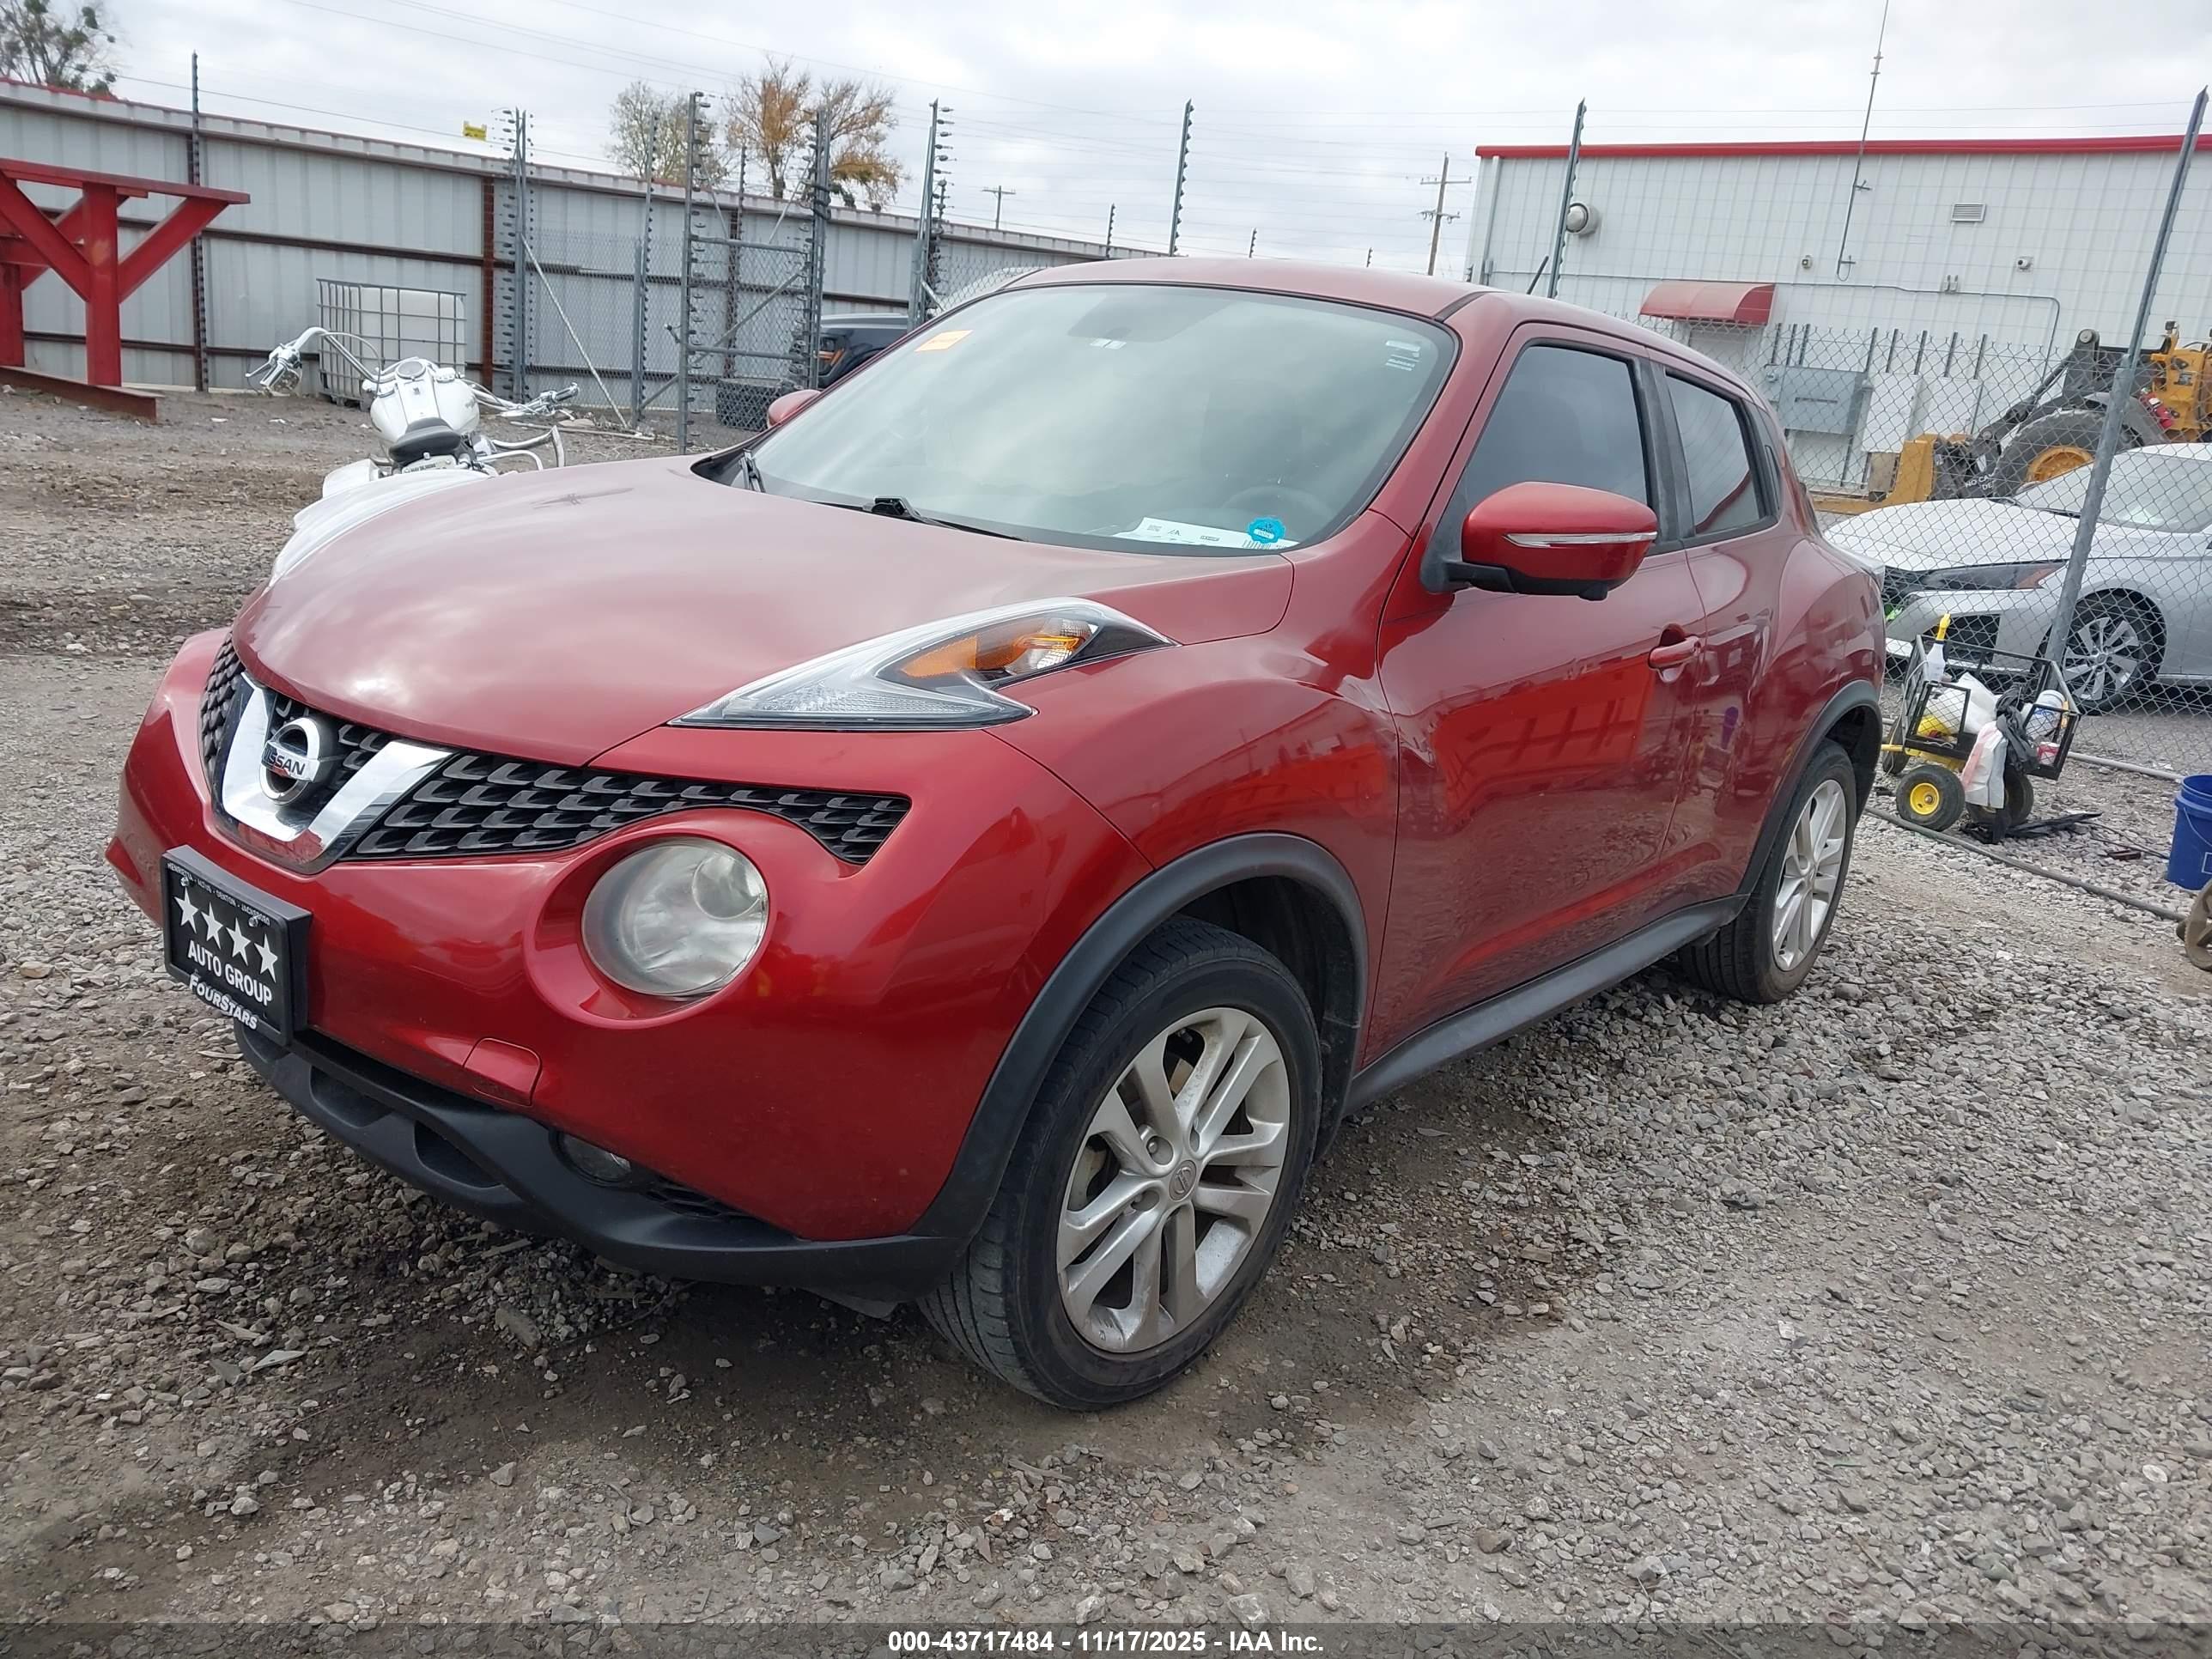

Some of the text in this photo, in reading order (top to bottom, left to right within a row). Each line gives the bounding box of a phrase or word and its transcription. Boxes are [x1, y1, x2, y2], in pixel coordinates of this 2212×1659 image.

[261, 745, 306, 776] NISSAN
[188, 939, 273, 1006] AUTO GROUP
